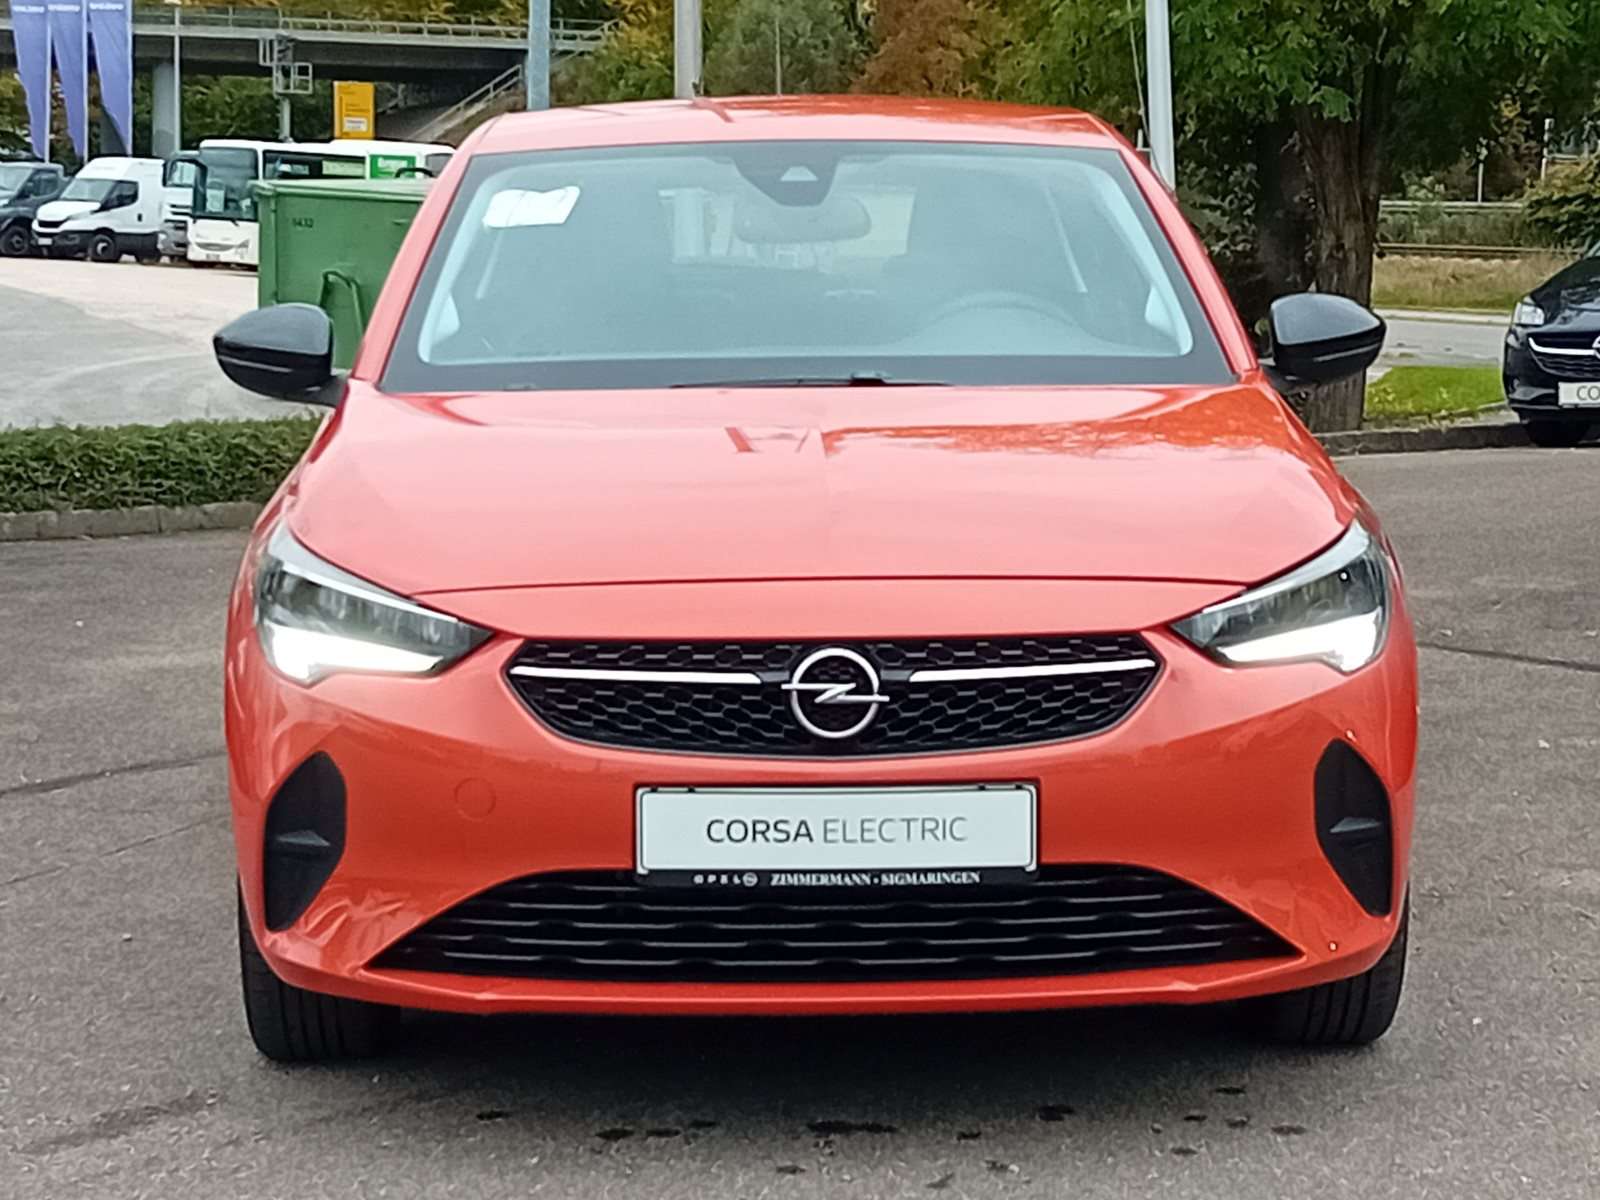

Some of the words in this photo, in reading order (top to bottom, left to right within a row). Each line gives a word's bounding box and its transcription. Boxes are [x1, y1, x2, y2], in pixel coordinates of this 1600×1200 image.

[706, 818, 814, 844] CORSA
[822, 816, 968, 844] ELECTRIC
[770, 872, 871, 886] ZIMMERMANN
[881, 871, 981, 886] SIGMARINGEN
